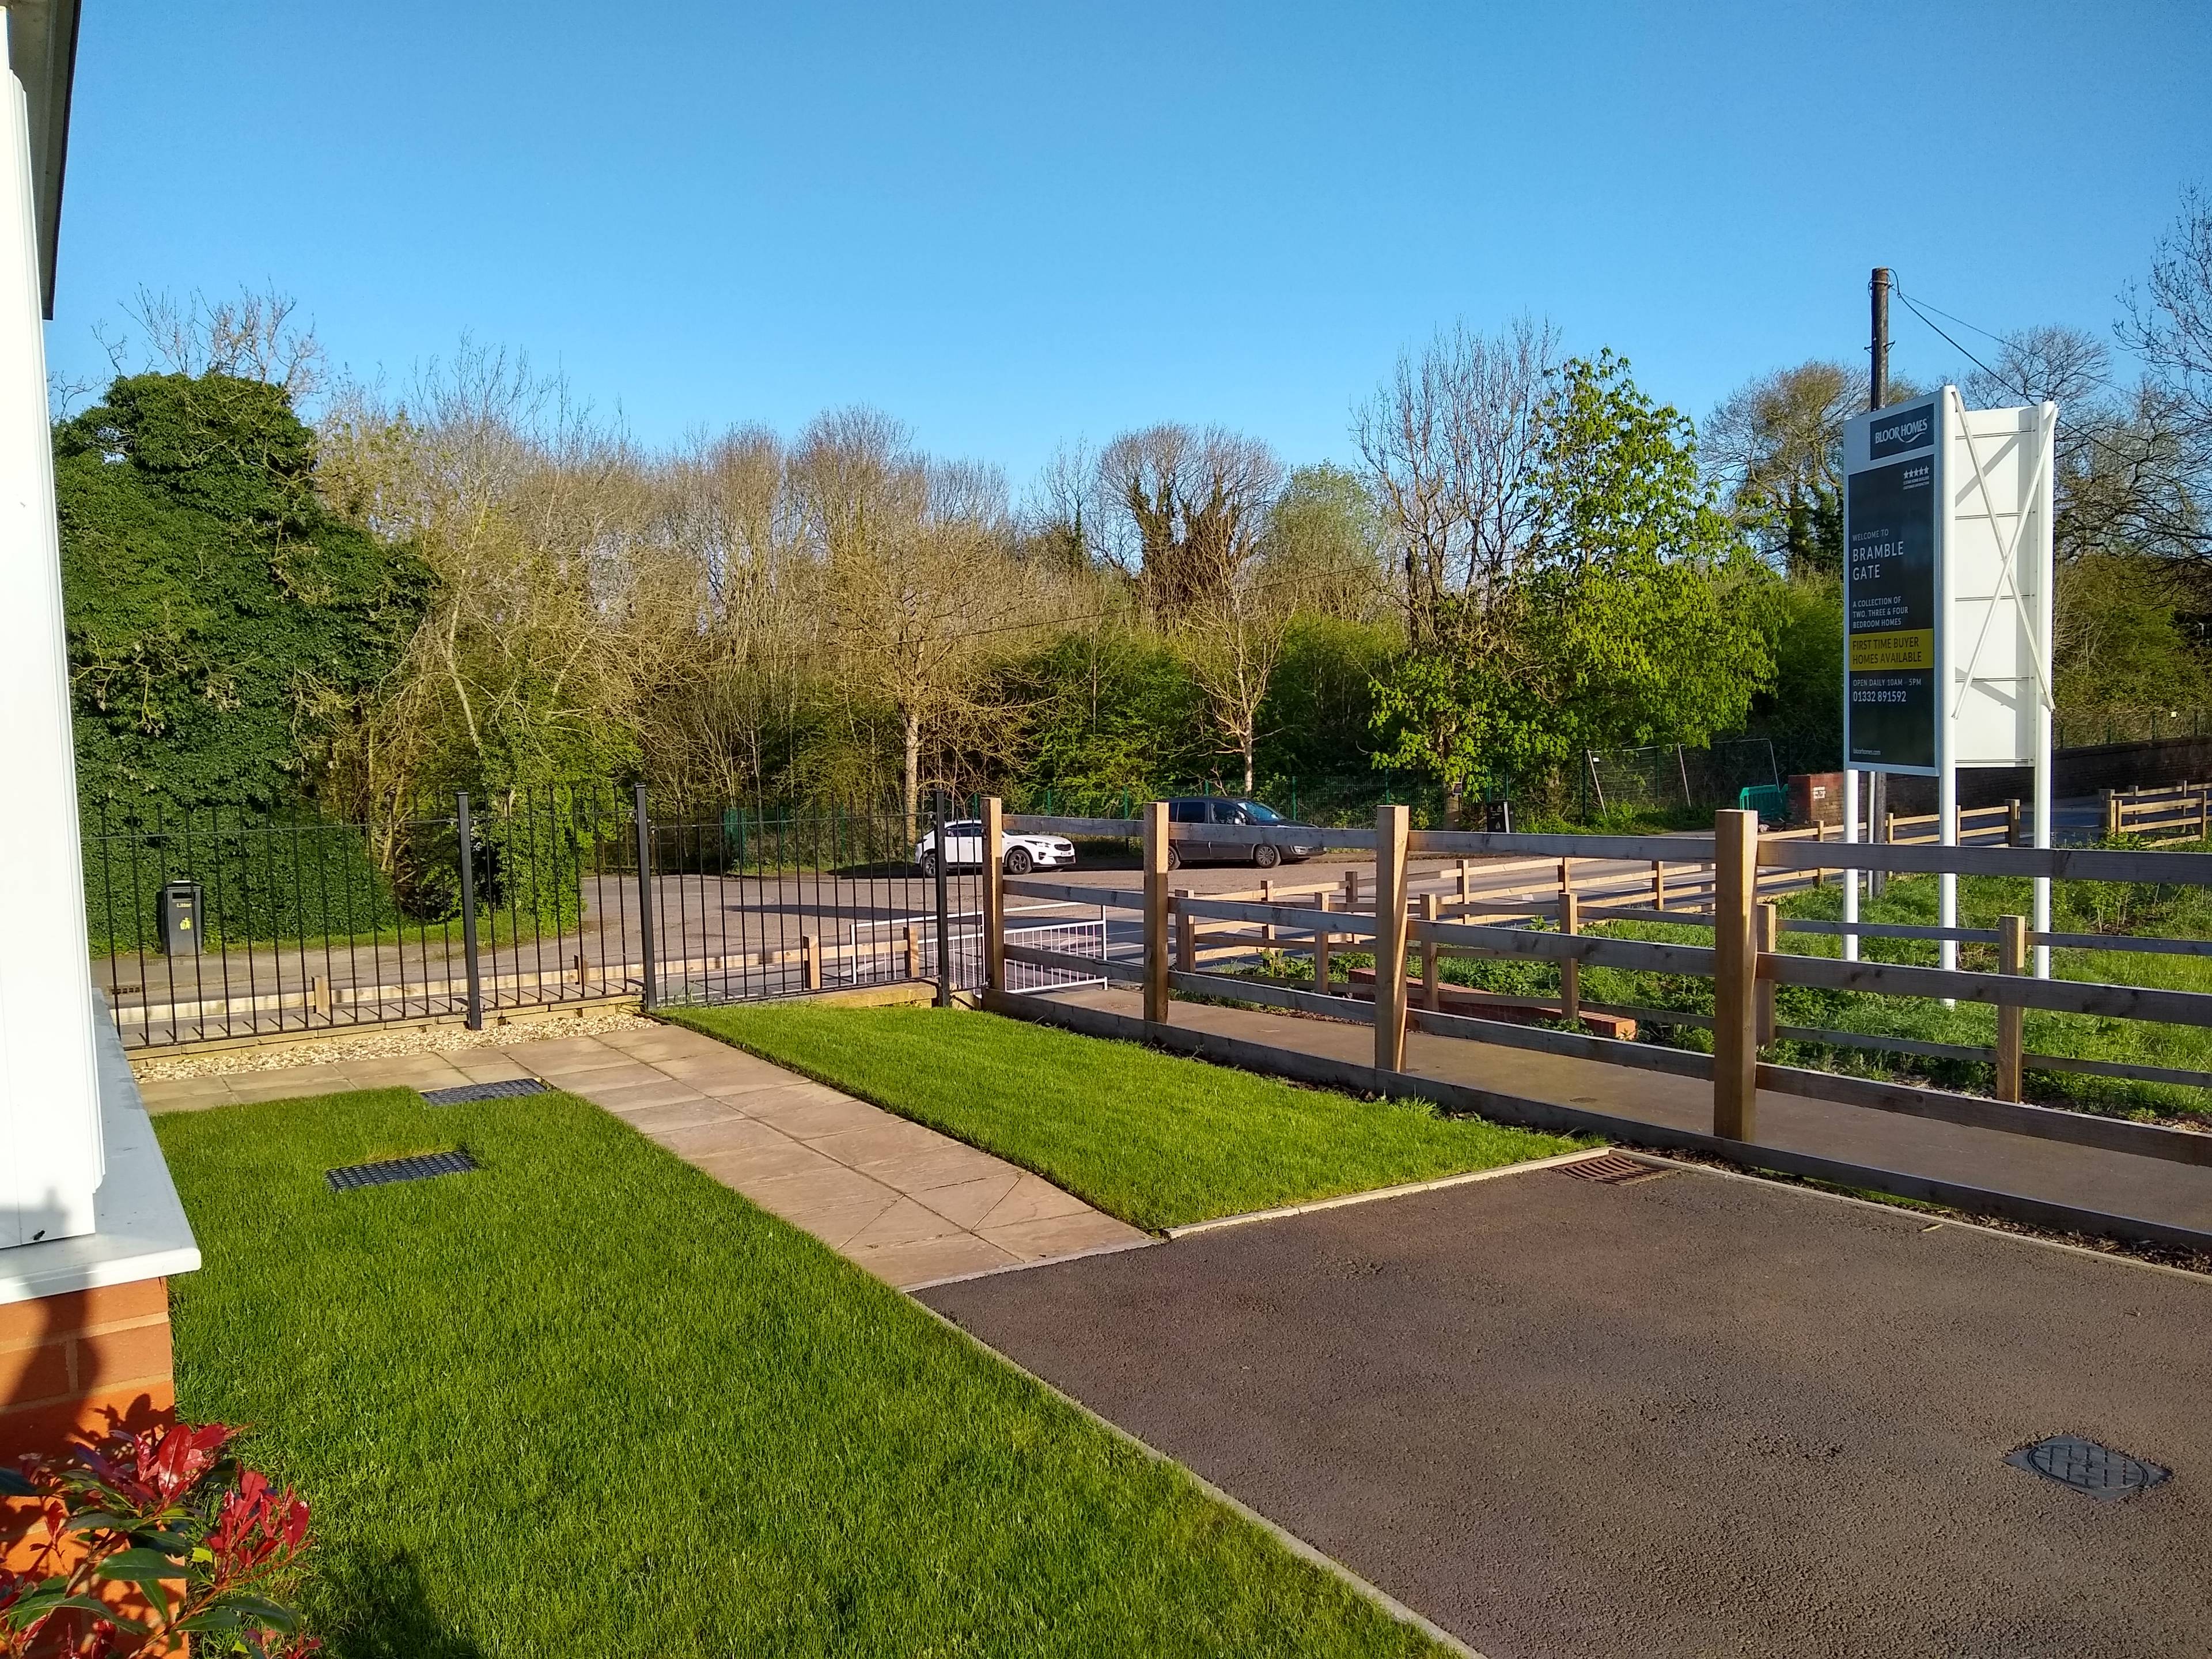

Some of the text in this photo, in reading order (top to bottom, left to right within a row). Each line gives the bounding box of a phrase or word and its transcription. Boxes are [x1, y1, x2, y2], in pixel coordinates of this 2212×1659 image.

[1875, 418, 1927, 444] BLOOR HOMES
[1853, 530, 1880, 541] WELCOME
[1853, 541, 1904, 562] BRAMBLE
[1853, 564, 1880, 581] GATE
[1858, 596, 1892, 607] COLLECTION
[1893, 596, 1902, 604] OF
[1868, 608, 1886, 617] THREE
[1893, 606, 1908, 615] FOUR
[1853, 618, 1902, 628] BEDROOM HOMES
[1853, 637, 1919, 650] FIRST TIME BUYER
[1853, 652, 1922, 665] HOMES AVAILABLE
[1853, 691, 1907, 702] 01332 891592
